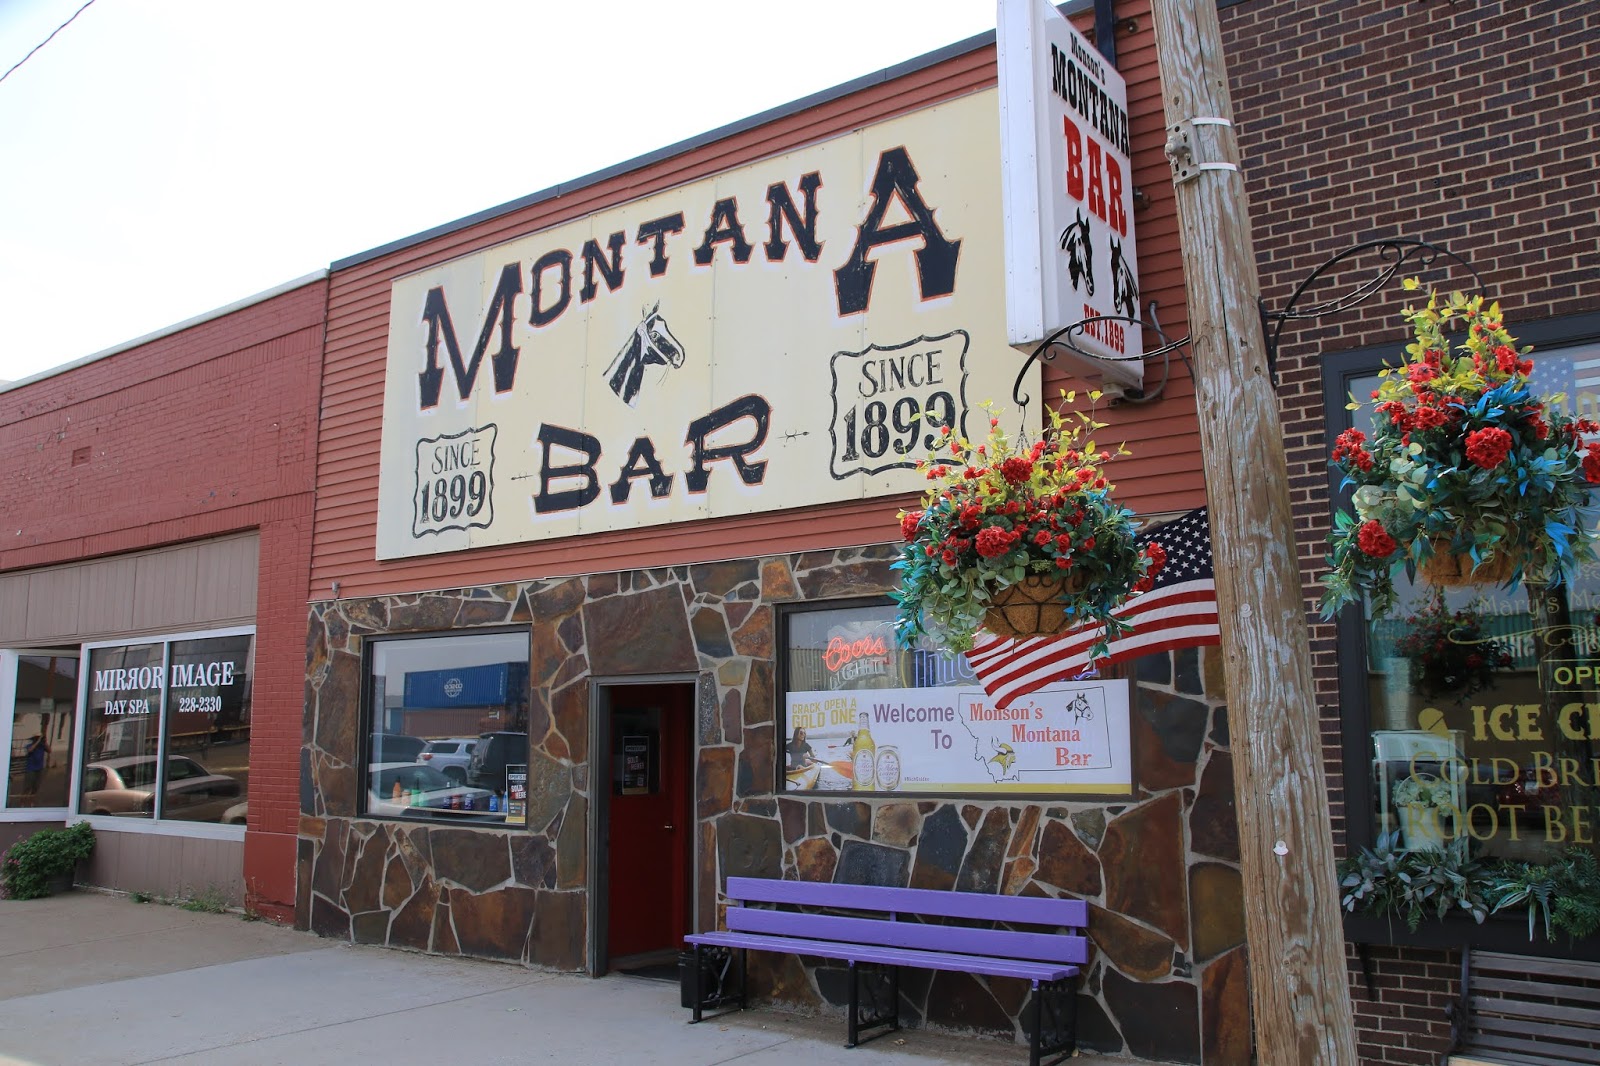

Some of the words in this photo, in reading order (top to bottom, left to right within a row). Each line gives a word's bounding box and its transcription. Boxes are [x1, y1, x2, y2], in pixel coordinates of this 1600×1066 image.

[1051, 42, 1131, 158] MONTANA
[1063, 114, 1127, 238] BAR
[418, 145, 964, 410] MONTANA
[858, 350, 944, 398] SINCE
[841, 391, 956, 463] 1899
[431, 439, 481, 475] SINCE
[532, 393, 773, 515] BAR
[420, 470, 487, 524] 1899
[1479, 592, 1560, 621] Mary's
[822, 634, 887, 672] Coors
[170, 661, 234, 688] IMAGE
[104, 700, 127, 715] DAY
[128, 699, 150, 714] SPA
[179, 696, 222, 713] 228-2330
[792, 701, 820, 715] CRACK
[824, 698, 847, 711] OPEN
[850, 697, 857, 708] A
[792, 712, 825, 729] GOLD
[831, 708, 857, 725] ONE
[873, 703, 955, 723] Welcome
[970, 701, 1044, 722] Monson's
[1470, 703, 1544, 741] ICE
[931, 729, 952, 749] To
[1012, 724, 1081, 743] Montana
[1055, 747, 1092, 766] Bar
[1409, 750, 1520, 788] COLD
[1406, 803, 1526, 841] ROOT
